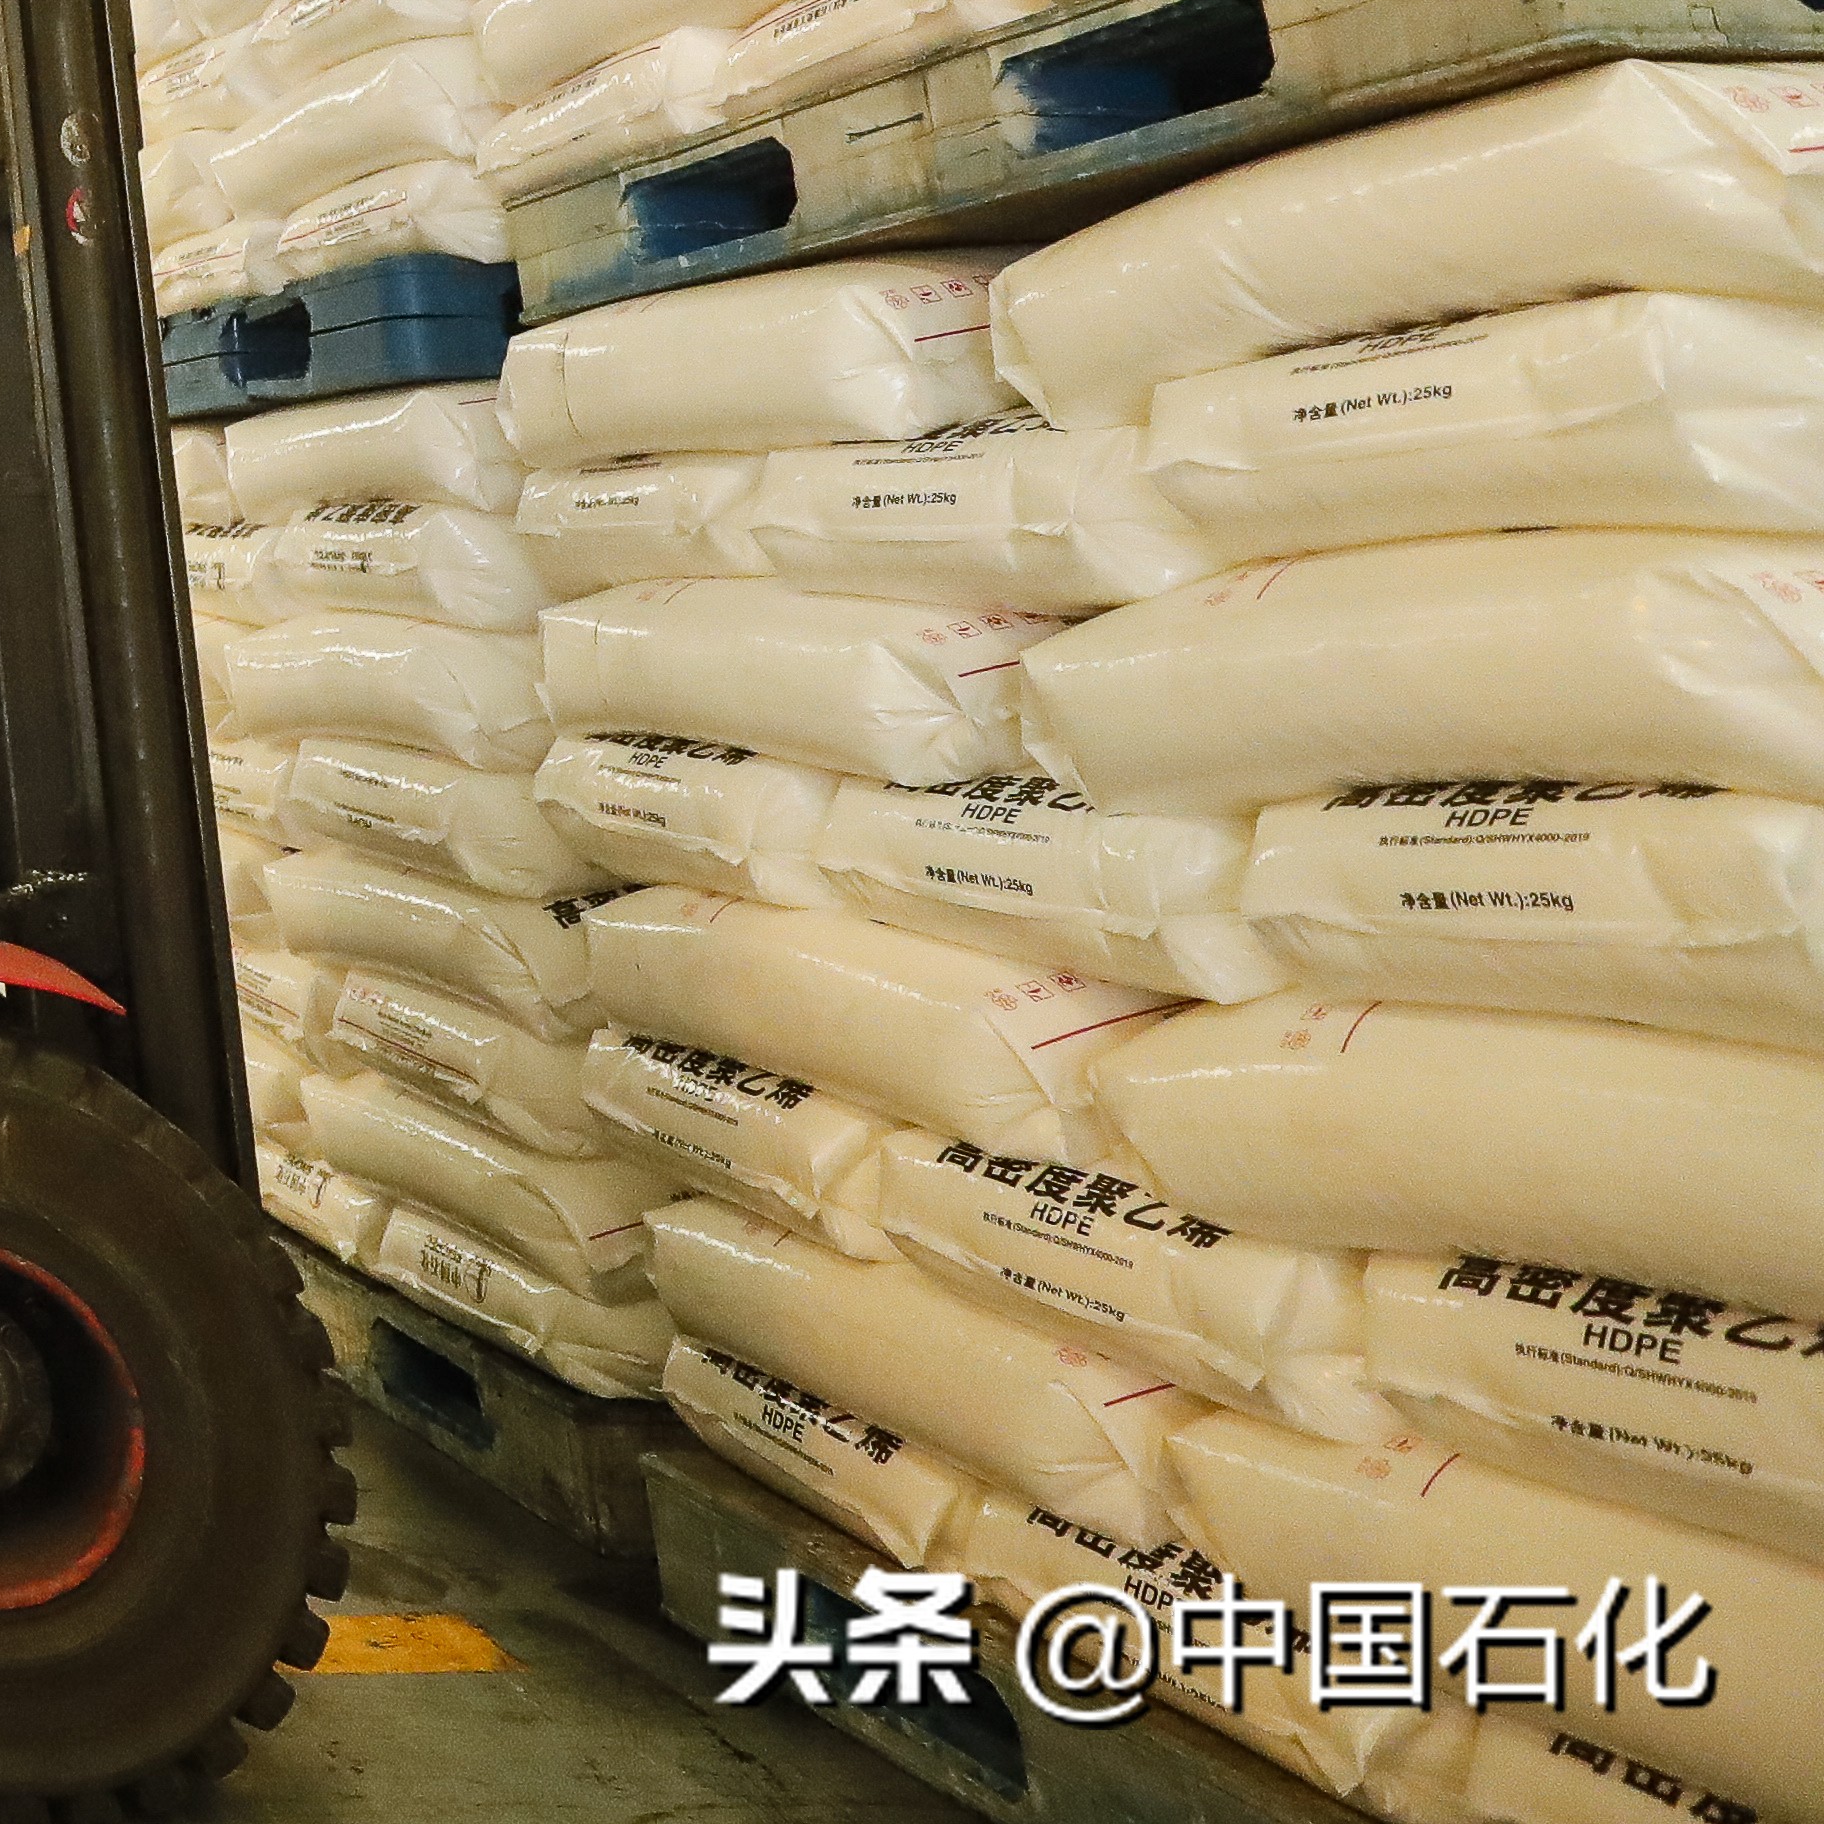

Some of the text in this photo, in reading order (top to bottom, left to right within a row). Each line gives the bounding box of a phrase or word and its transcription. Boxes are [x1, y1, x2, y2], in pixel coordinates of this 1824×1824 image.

[901, 439, 964, 454] HDPE
[628, 751, 669, 769] HDPE
[960, 802, 1023, 824] HDPE
[1444, 807, 1535, 829] HDPE
[1399, 889, 1575, 912] 净含量(Net Wt.):25kg
[935, 1139, 1234, 1250] 高密度聚乙烯
[1029, 1200, 1096, 1237] HDPE
[1581, 1322, 1686, 1366] HDPE
[761, 1403, 806, 1444] HDPE
[1123, 1574, 1175, 1610] HDP
